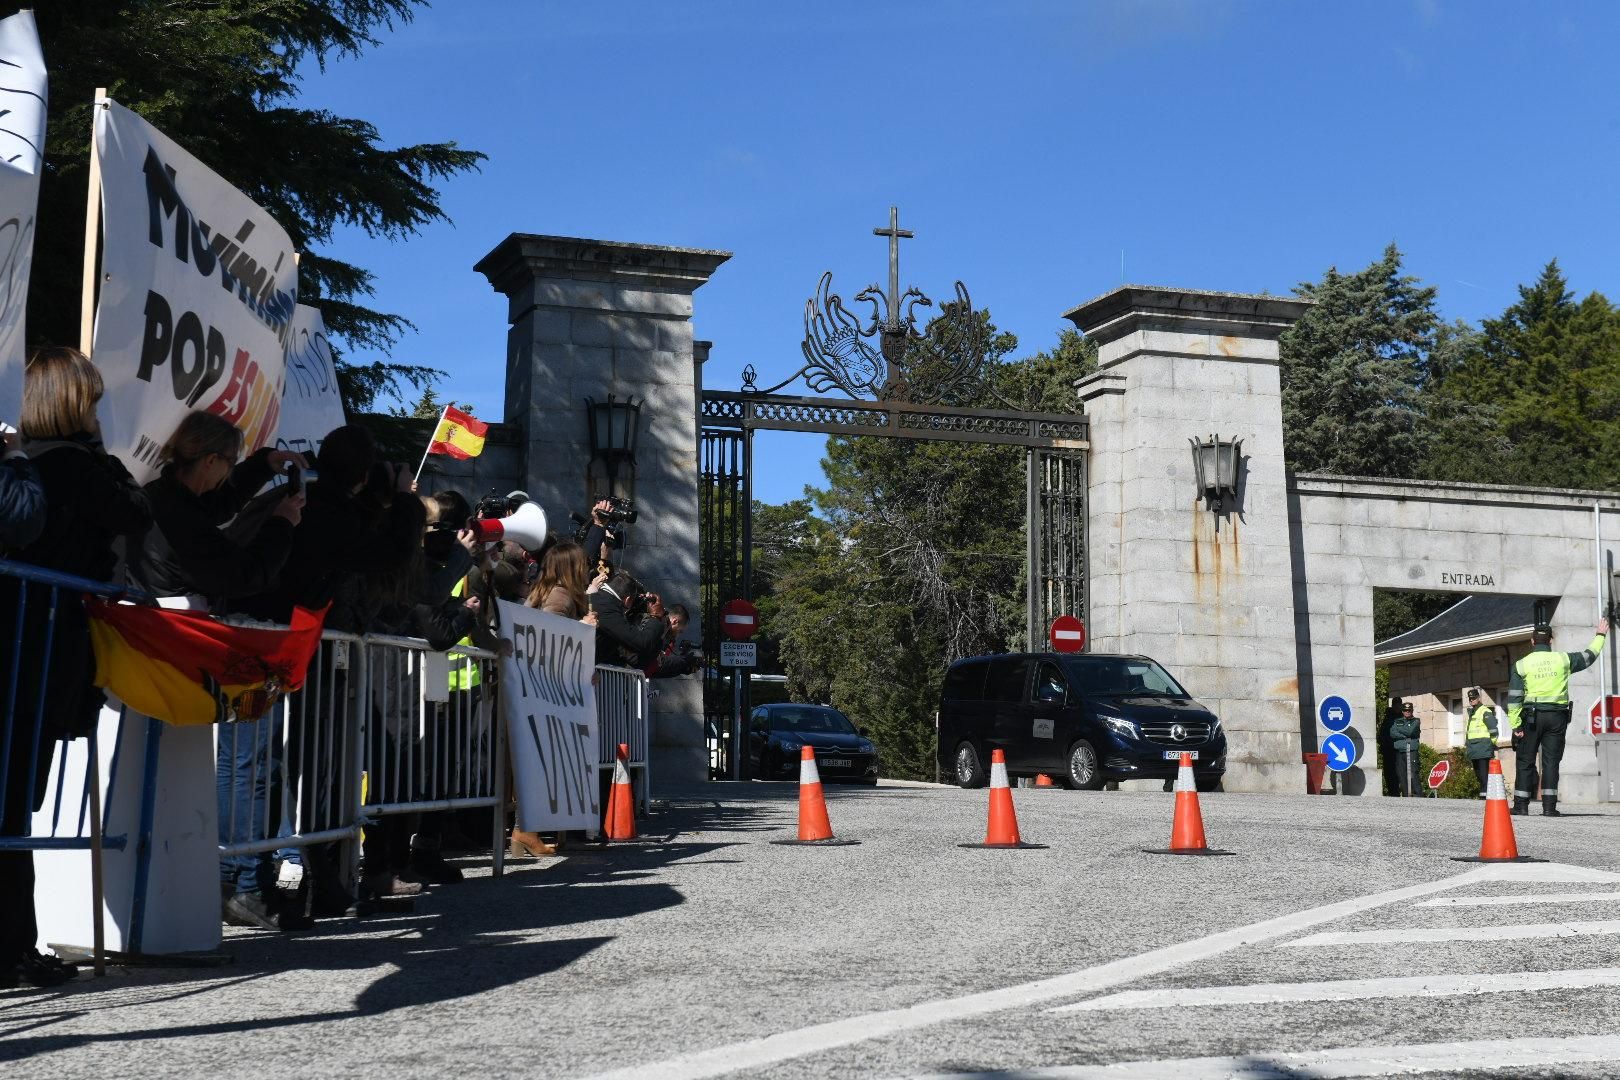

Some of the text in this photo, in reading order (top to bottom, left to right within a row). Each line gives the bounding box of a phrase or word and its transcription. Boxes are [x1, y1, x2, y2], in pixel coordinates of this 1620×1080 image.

[136, 289, 226, 409] POR
[1441, 572, 1495, 586] ENTRADA
[513, 622, 585, 707] FRANCO
[1593, 715, 1620, 729] STO
[527, 714, 599, 816] VIVE
[1430, 769, 1447, 778] STOP
